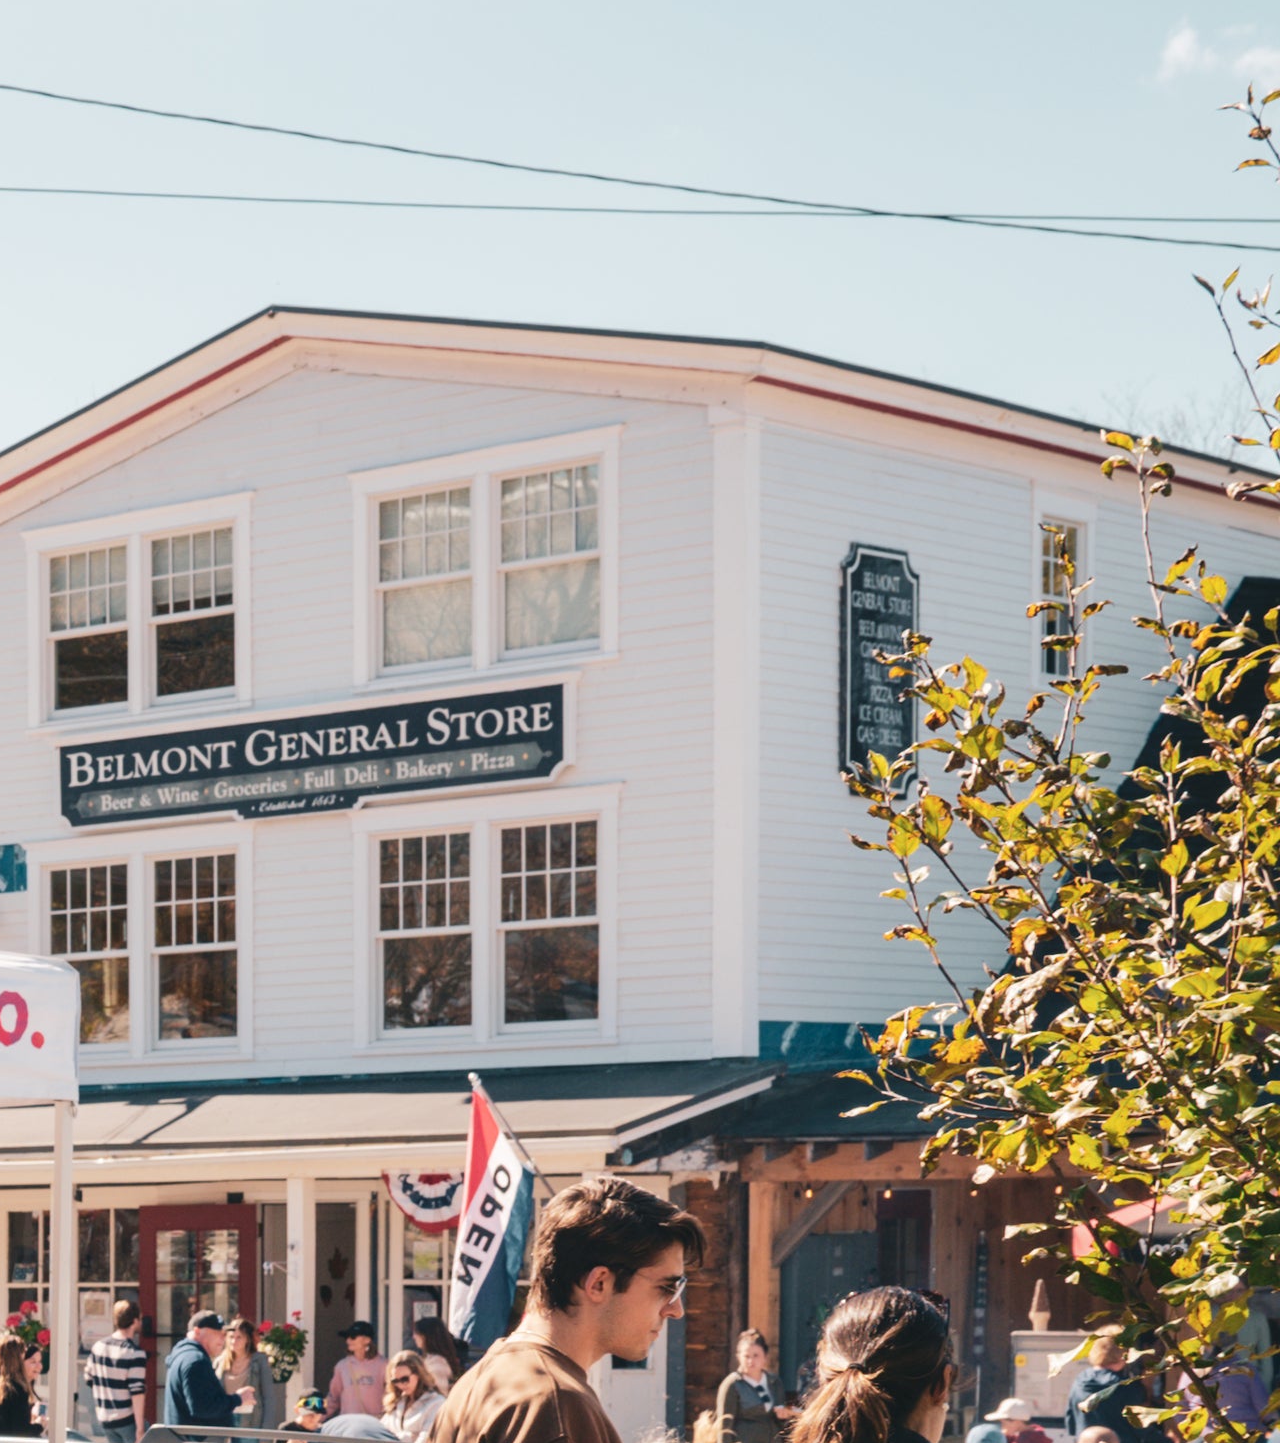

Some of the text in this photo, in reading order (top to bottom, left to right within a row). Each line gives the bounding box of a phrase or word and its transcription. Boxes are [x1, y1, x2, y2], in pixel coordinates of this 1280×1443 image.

[863, 571, 900, 593] BELMONT
[66, 702, 554, 788] BELMONT GENERAL STORE
[99, 751, 515, 812] Beer & Wine Groceries Full Deli Bakery Pizza
